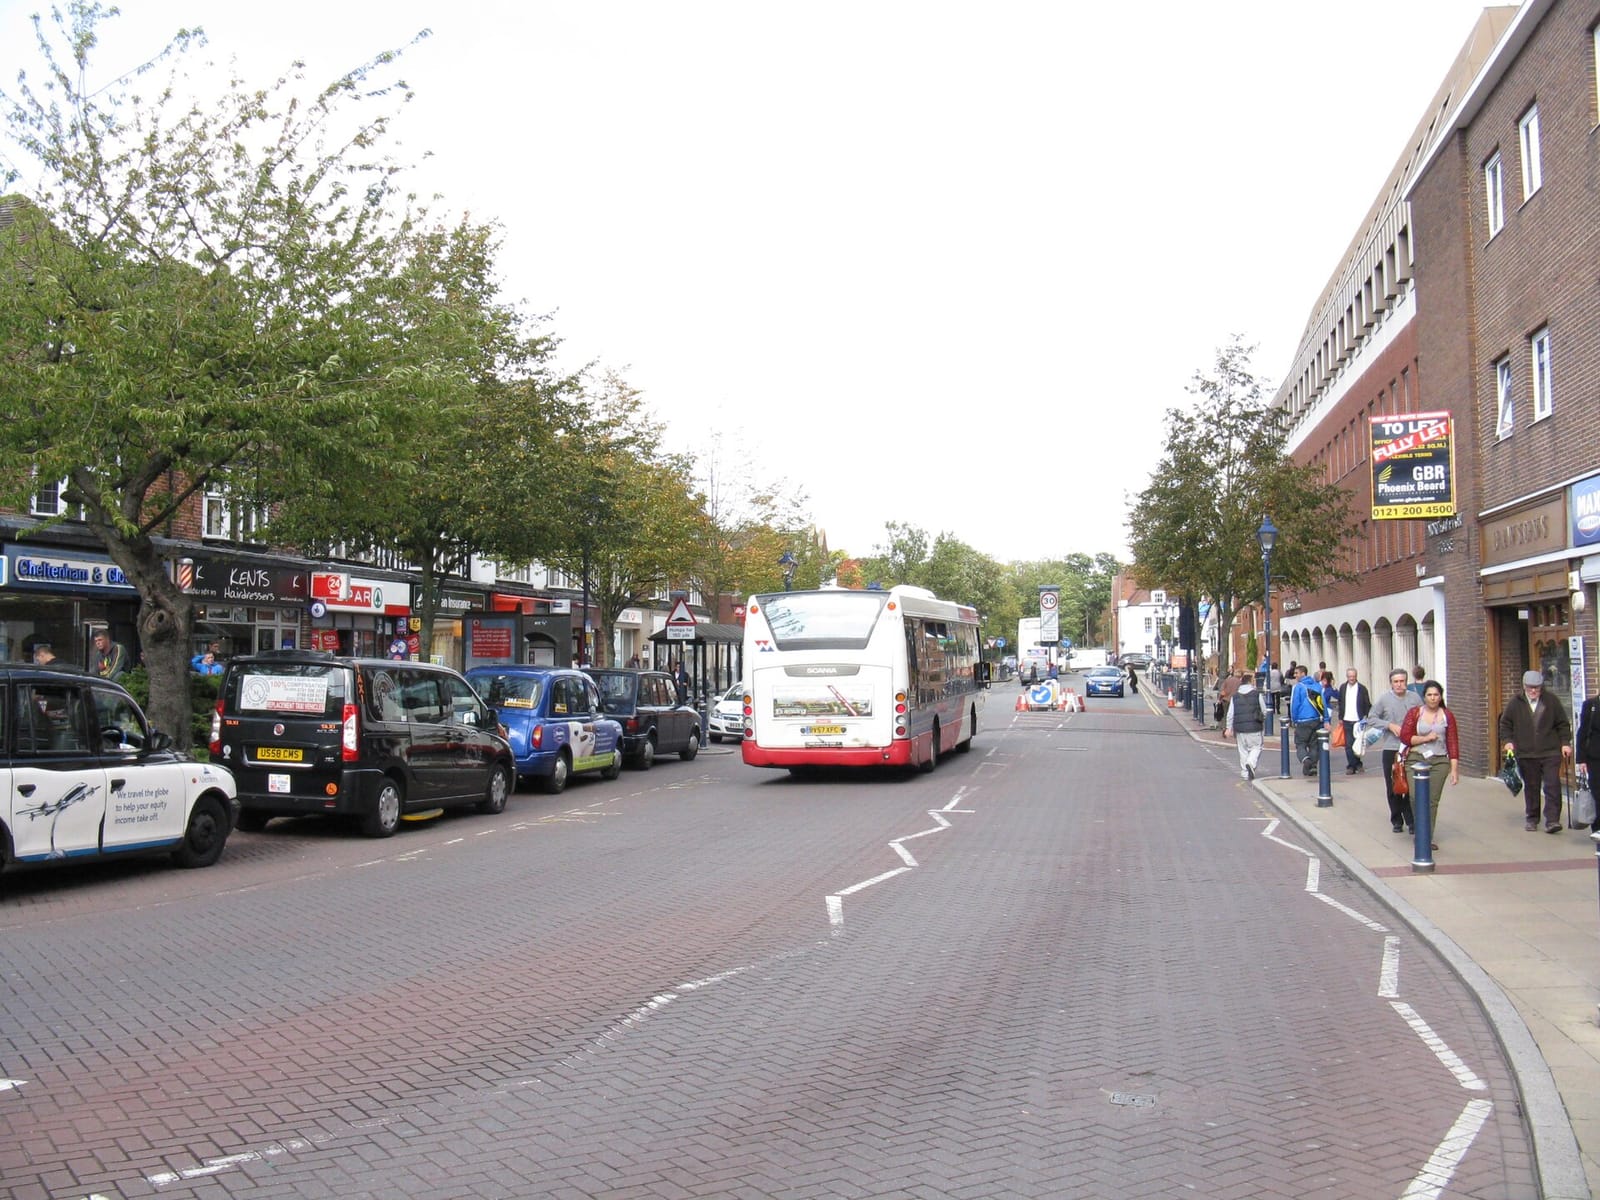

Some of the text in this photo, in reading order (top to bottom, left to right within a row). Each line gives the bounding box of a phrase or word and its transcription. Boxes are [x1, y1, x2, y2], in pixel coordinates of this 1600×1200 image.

[1382, 422, 1404, 435] TO
[1373, 421, 1447, 461] FULLY LET
[1412, 465, 1445, 481] GBR
[1378, 480, 1446, 493] Phoenix Beard
[1373, 505, 1453, 517] 0121 200 4500
[18, 559, 89, 581] Cheltenham
[92, 567, 103, 582] &
[195, 566, 205, 580] K
[230, 568, 270, 587] KENTS
[292, 575, 300, 588] K
[329, 579, 341, 588] 24
[224, 587, 275, 601] Hairdressers
[1043, 597, 1055, 605] 30
[355, 664, 365, 704] TAXI
[283, 750, 299, 759] CMS
[116, 787, 169, 799] We travel the globe
[115, 801, 167, 813] to help your equity
[115, 815, 136, 825] income
[137, 813, 149, 823] take
